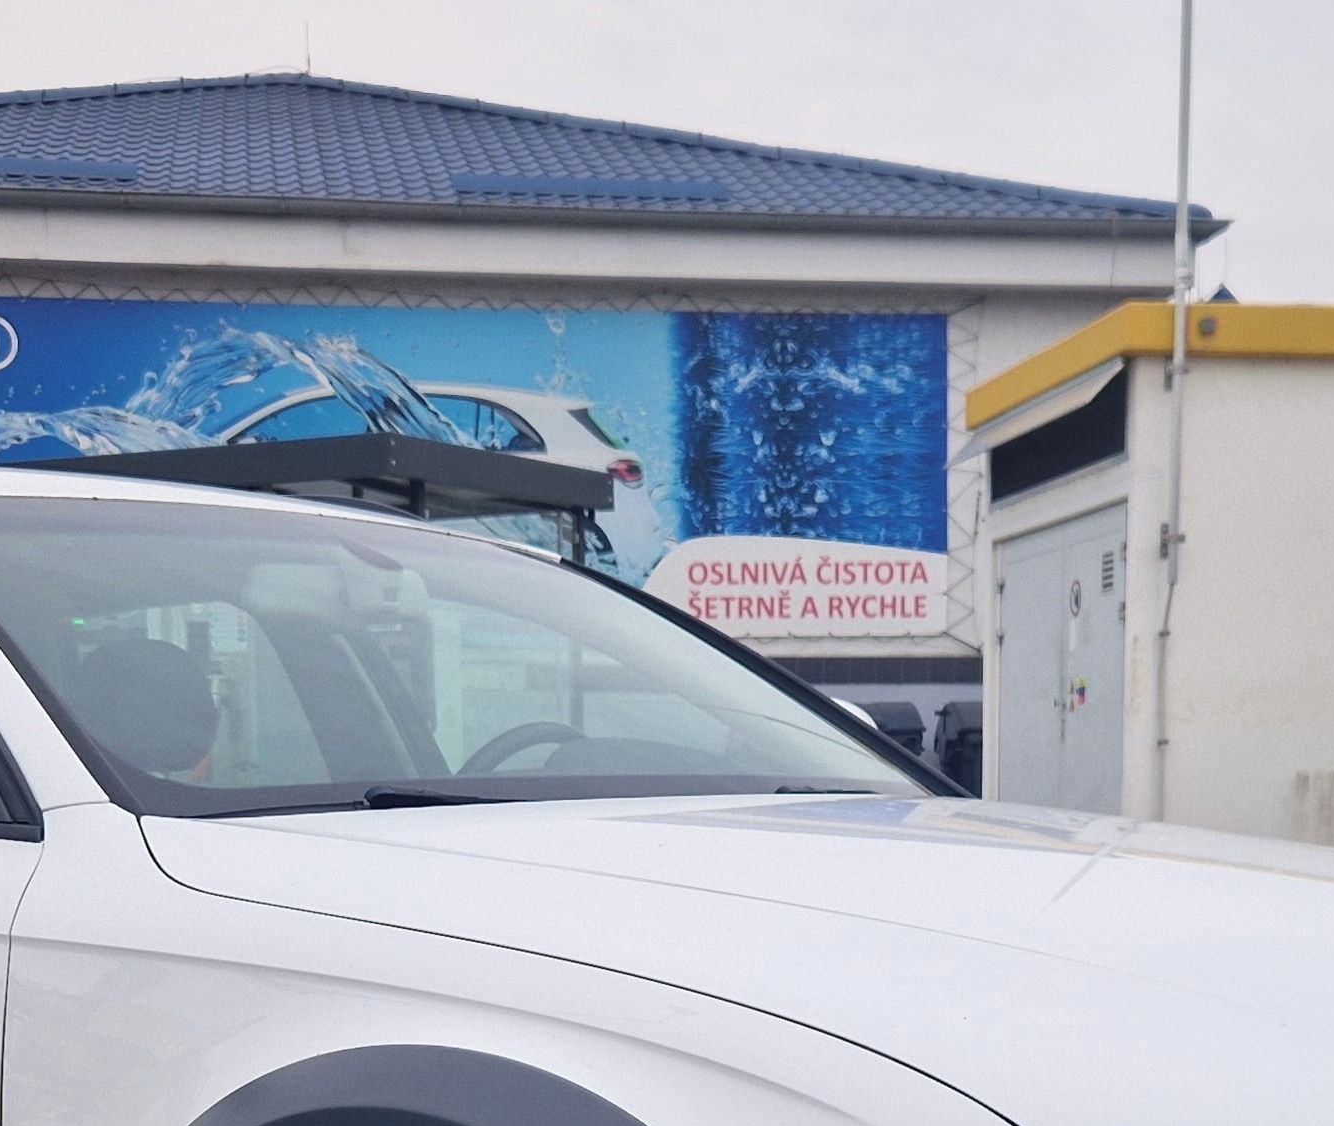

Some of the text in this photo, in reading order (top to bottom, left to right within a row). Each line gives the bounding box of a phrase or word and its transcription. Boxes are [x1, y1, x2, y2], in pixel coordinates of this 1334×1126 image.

[687, 556, 929, 585] OSLNIVÁ ČISTOTA
[688, 590, 927, 619] ŠETRNĚ A RYCHLE
